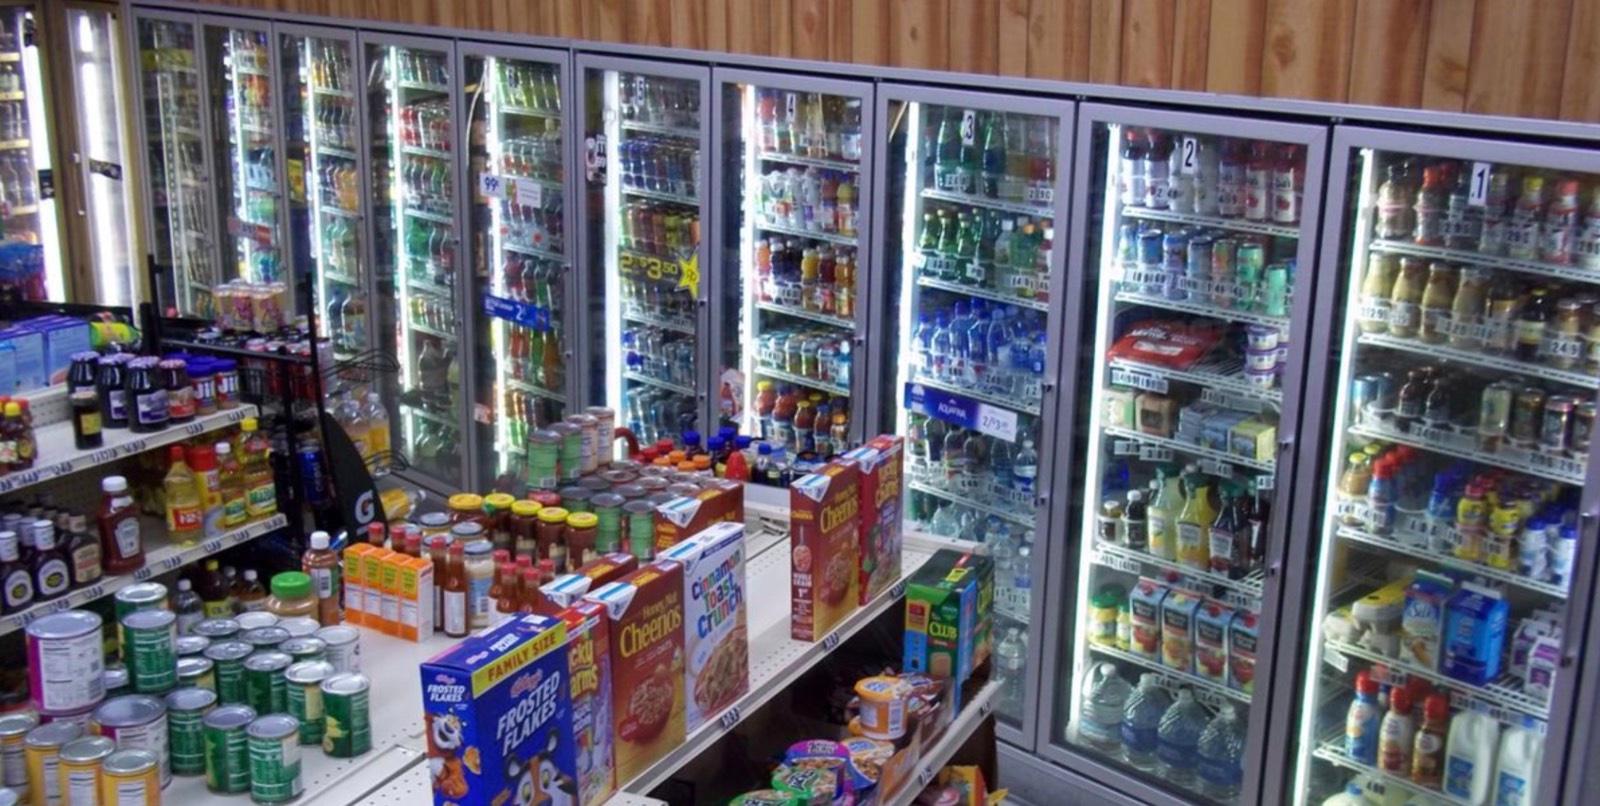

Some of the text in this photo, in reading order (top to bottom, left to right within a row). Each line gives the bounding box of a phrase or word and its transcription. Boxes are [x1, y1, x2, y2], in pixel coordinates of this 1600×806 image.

[965, 114, 974, 140] 3
[1184, 140, 1195, 167] 2
[1476, 167, 1487, 200] 1
[354, 488, 376, 525] G
[691, 548, 741, 601] Cinnamon
[703, 571, 735, 613] Toast
[619, 604, 682, 659] Cheerios
[697, 582, 743, 639] Crunch
[487, 650, 530, 683] FAMILY
[532, 632, 557, 656] SIZE
[427, 684, 466, 695] FROSTED
[430, 692, 463, 703] FLAKES
[495, 670, 561, 741] FROSTED
[501, 693, 558, 757] FLAKES
